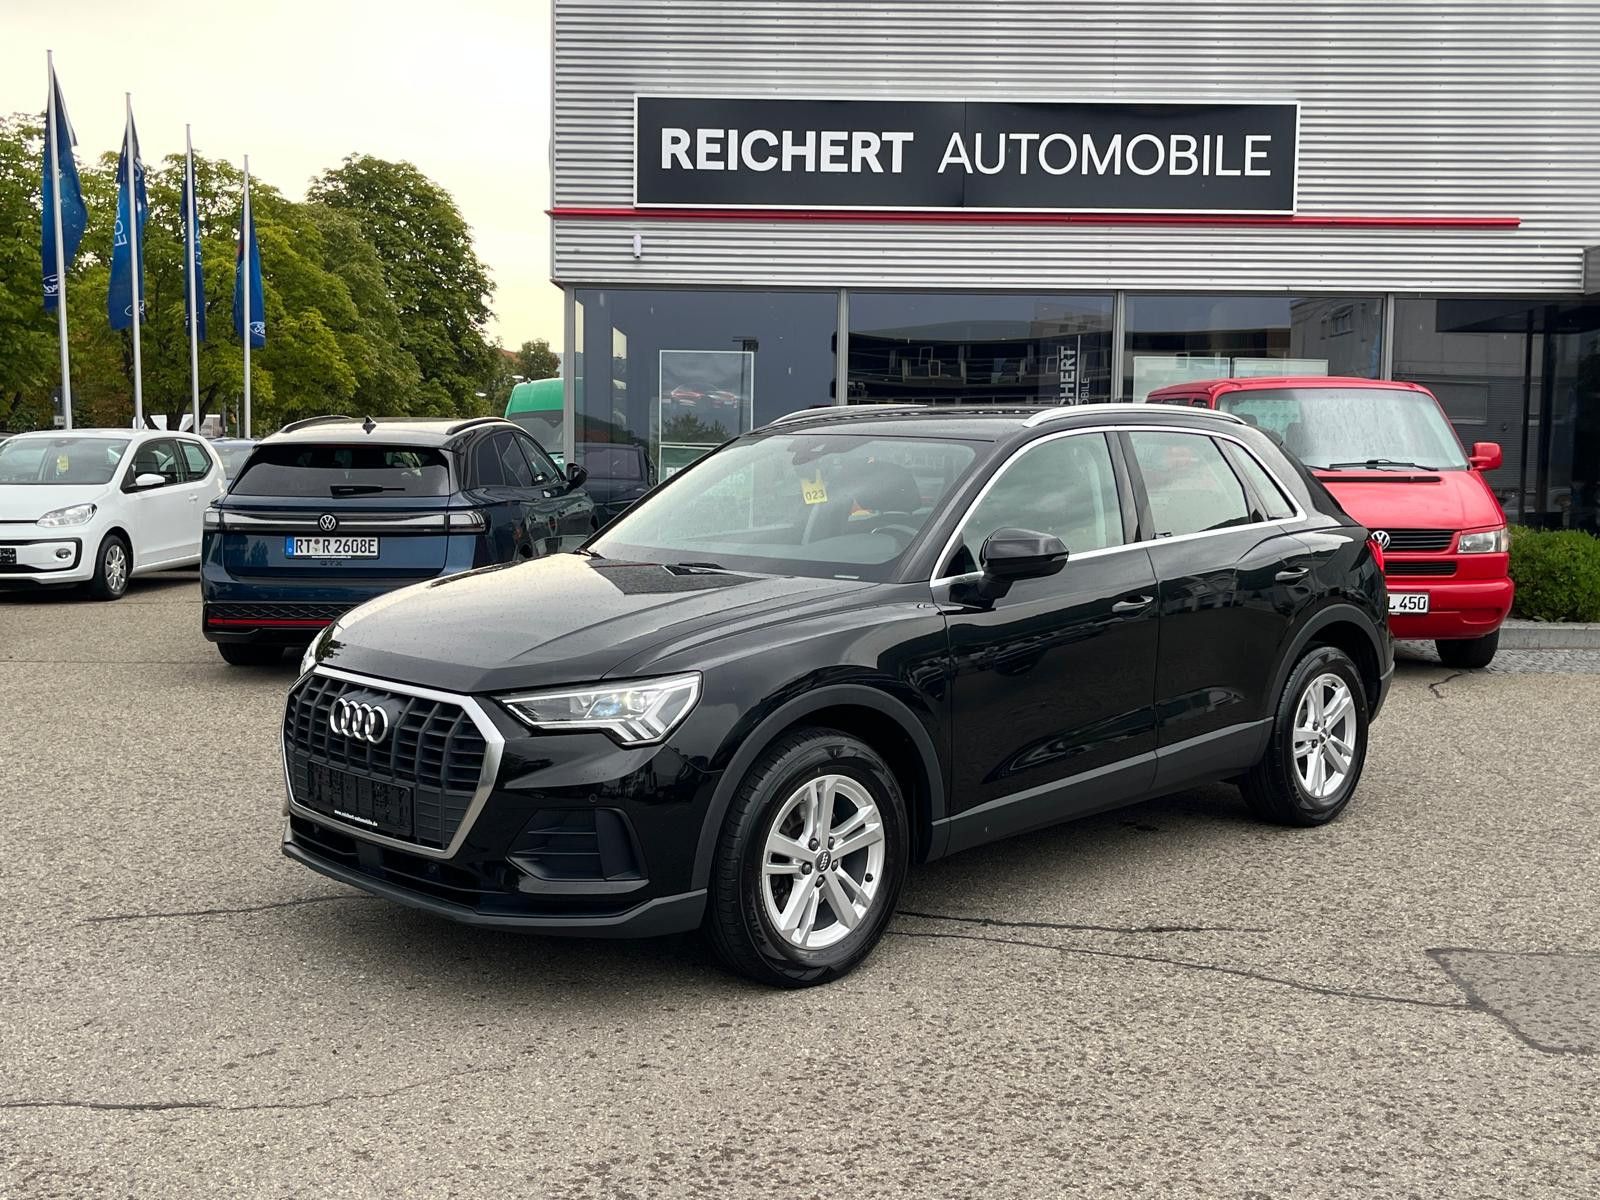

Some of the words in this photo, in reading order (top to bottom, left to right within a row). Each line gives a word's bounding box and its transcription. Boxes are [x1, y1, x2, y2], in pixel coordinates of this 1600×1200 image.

[661, 127, 914, 173] REICHERT
[937, 132, 1272, 177] AUTOMOBILE
[805, 489, 825, 501] 023
[295, 539, 312, 553] RT
[322, 539, 331, 553] R
[334, 539, 376, 553] 2608E
[1399, 596, 1426, 610] 450
